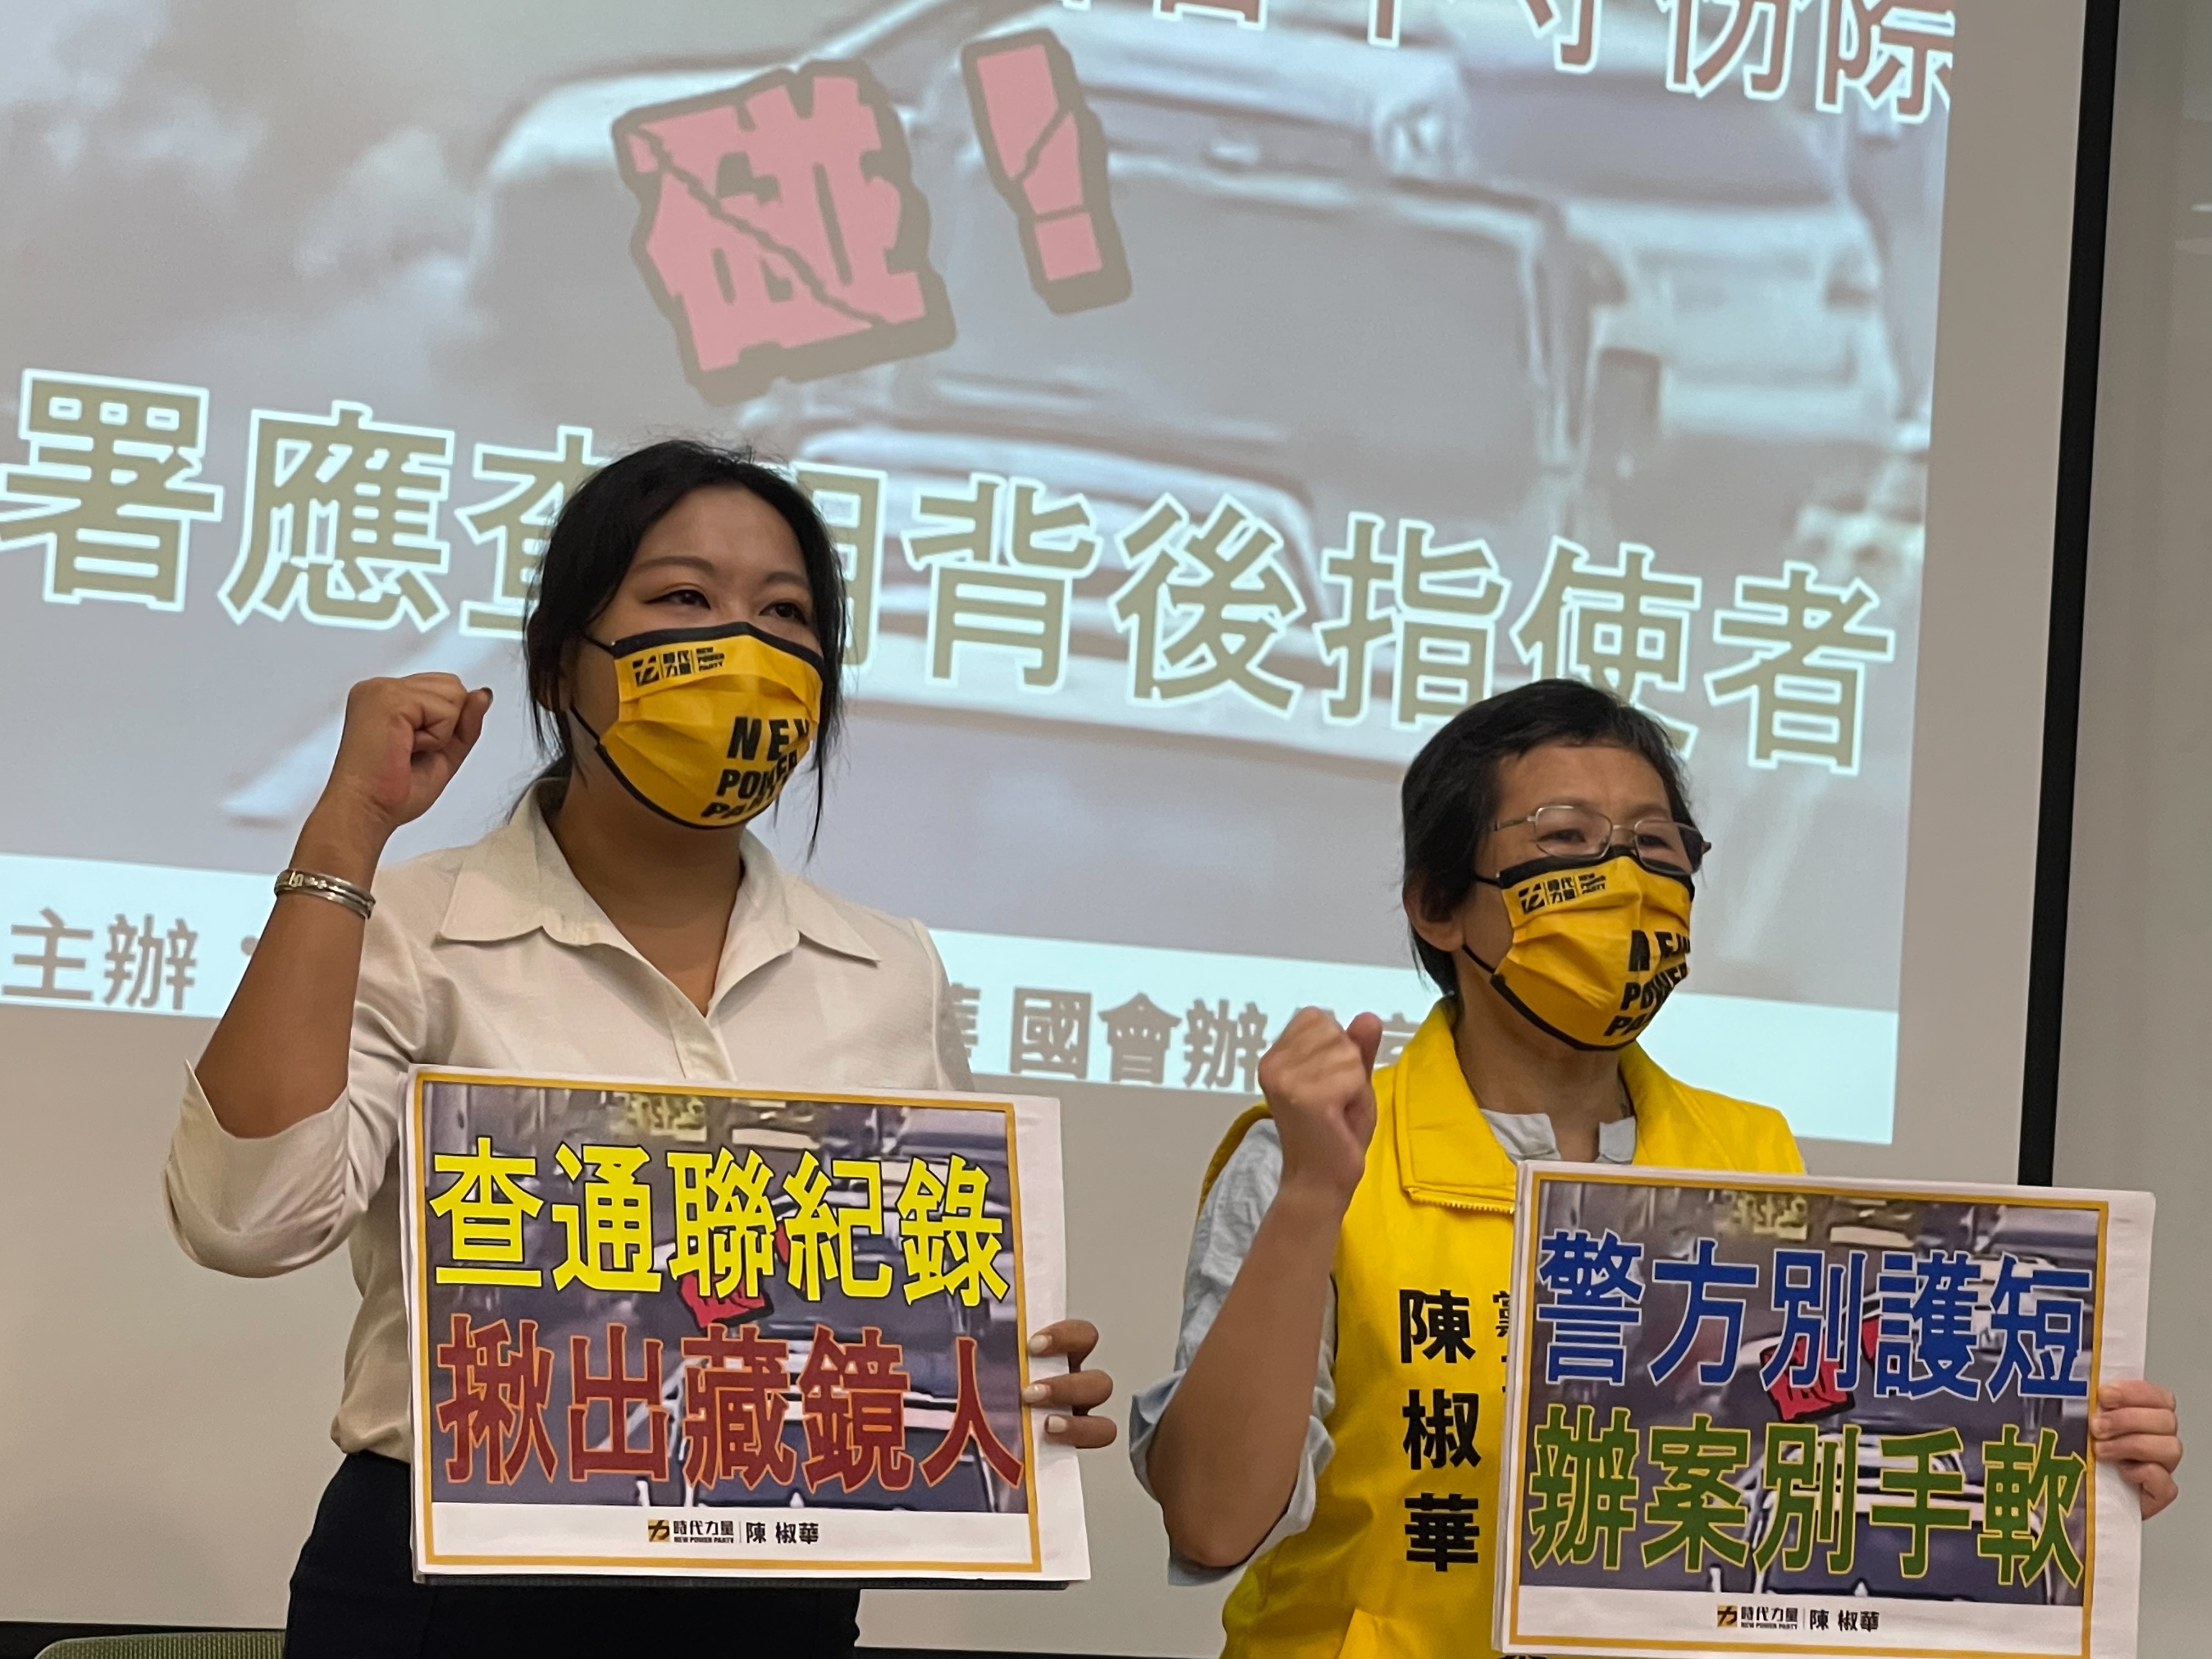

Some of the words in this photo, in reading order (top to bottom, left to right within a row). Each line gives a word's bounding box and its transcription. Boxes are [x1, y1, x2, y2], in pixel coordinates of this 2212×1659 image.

[0, 369, 1897, 775] 署應背後指使者
[429, 1137, 1010, 1307] 查通聯紀錄
[438, 1312, 1024, 1493] 揪出藏鏡人
[1538, 1229, 2091, 1401] 警方別護短
[1399, 1289, 1481, 1572] 陳椒華
[1528, 1403, 2087, 1587] 辦案別手軟
